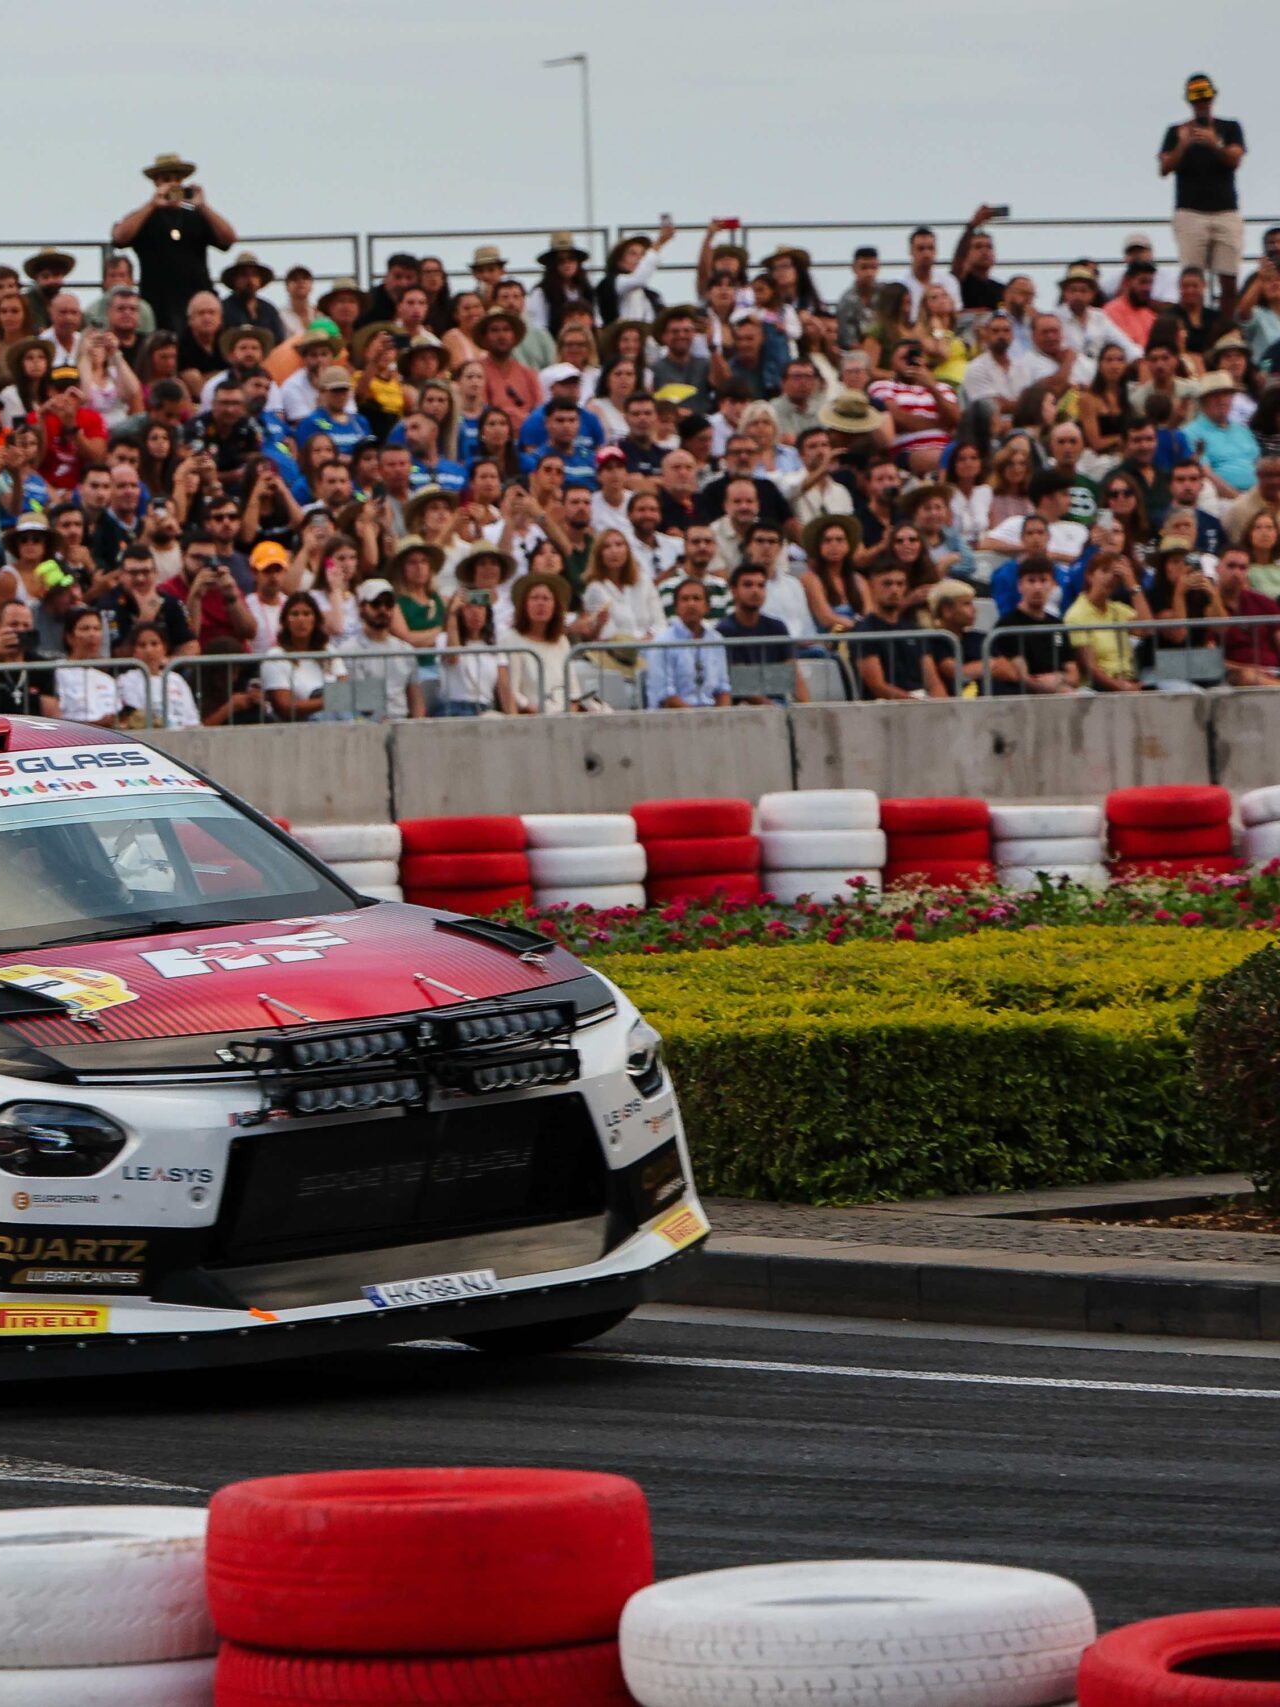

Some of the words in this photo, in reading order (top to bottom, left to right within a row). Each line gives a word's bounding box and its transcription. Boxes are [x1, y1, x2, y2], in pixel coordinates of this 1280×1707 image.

[122, 1165, 214, 1184] LEASYS
[32, 1193, 100, 1204] EUROREPAR
[26, 1270, 141, 1284] LUBRIFICANTES
